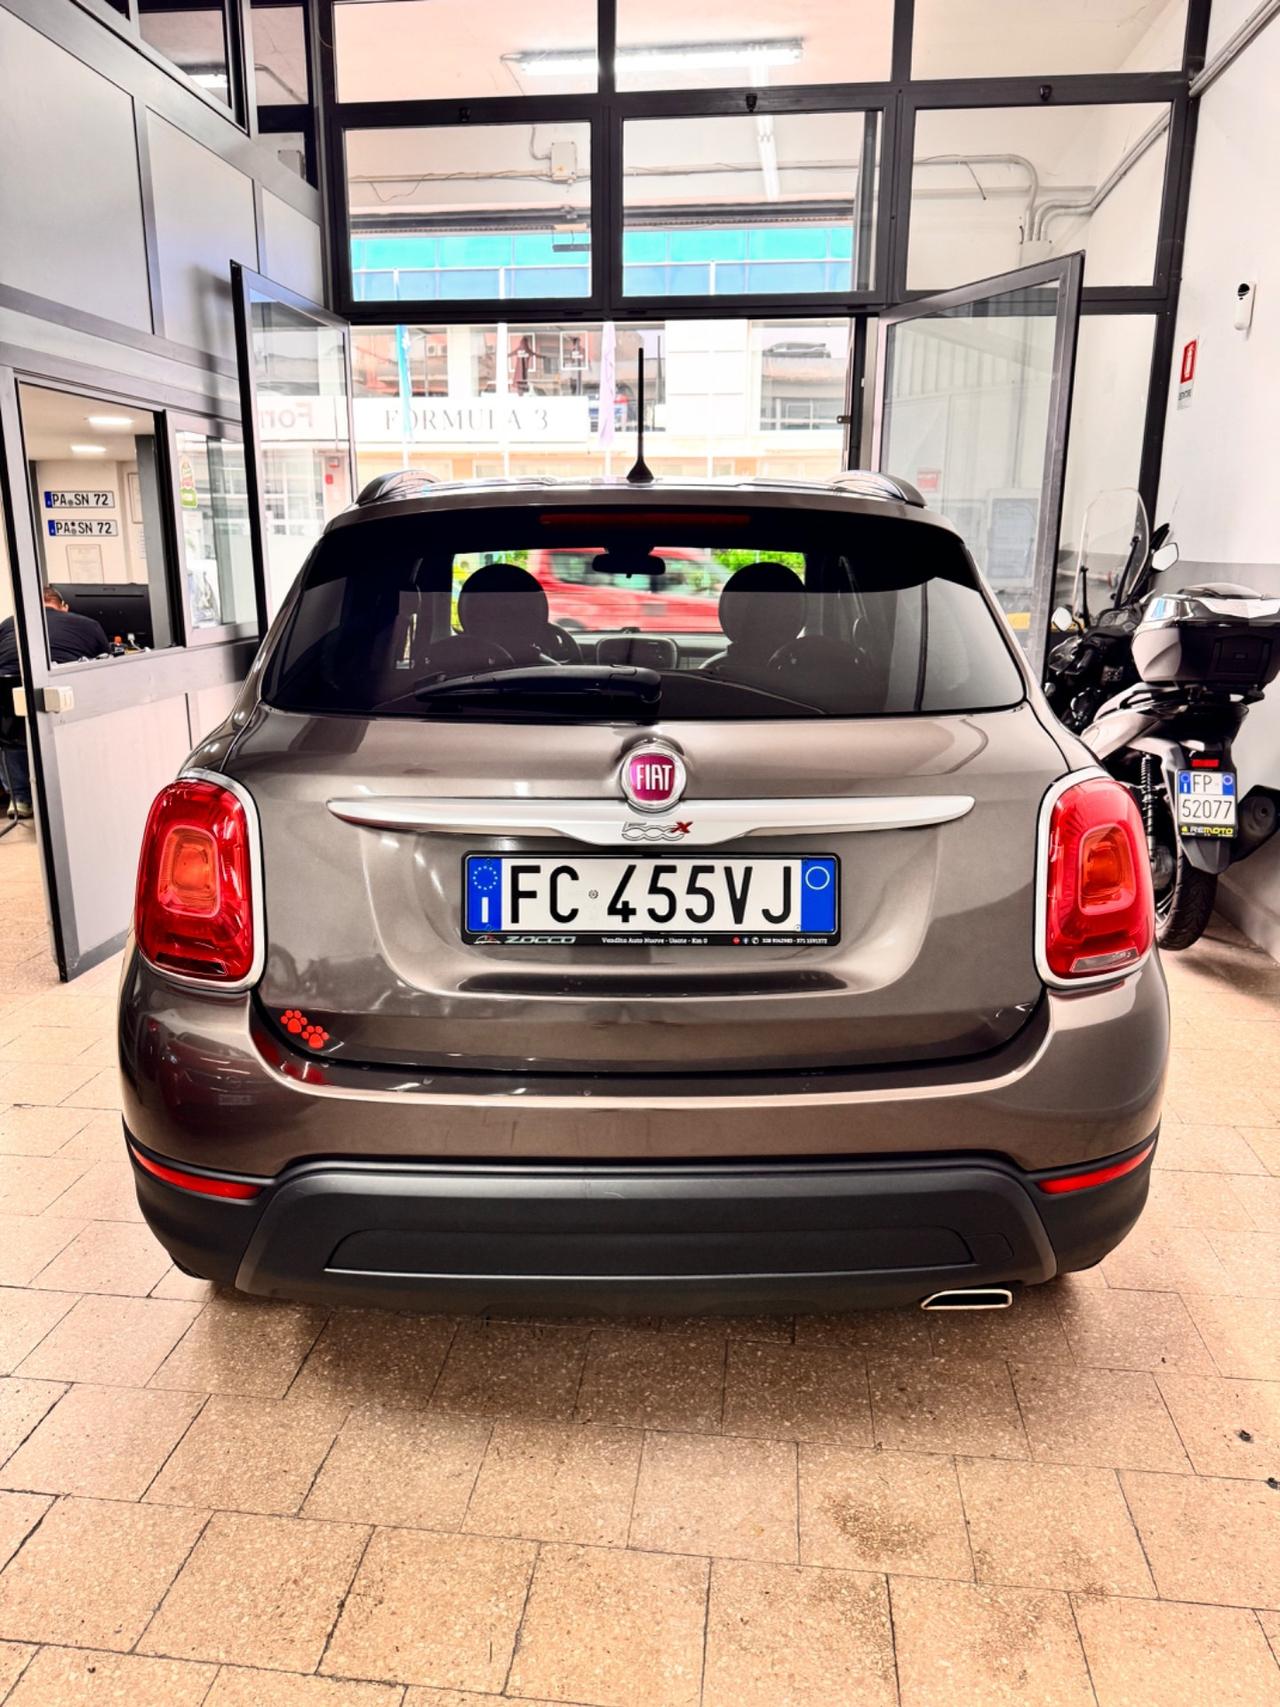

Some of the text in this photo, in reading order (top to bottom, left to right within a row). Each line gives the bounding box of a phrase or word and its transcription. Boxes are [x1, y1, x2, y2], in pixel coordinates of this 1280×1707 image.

[534, 408, 549, 431] 3
[53, 493, 109, 506] PA SN 72
[56, 522, 112, 535] PA SN 72
[636, 764, 673, 791] FIAT
[1193, 774, 1213, 793] FP
[1182, 799, 1233, 819] 52077
[510, 864, 792, 925] FC 455VJ
[504, 935, 577, 945] ZOCCO
